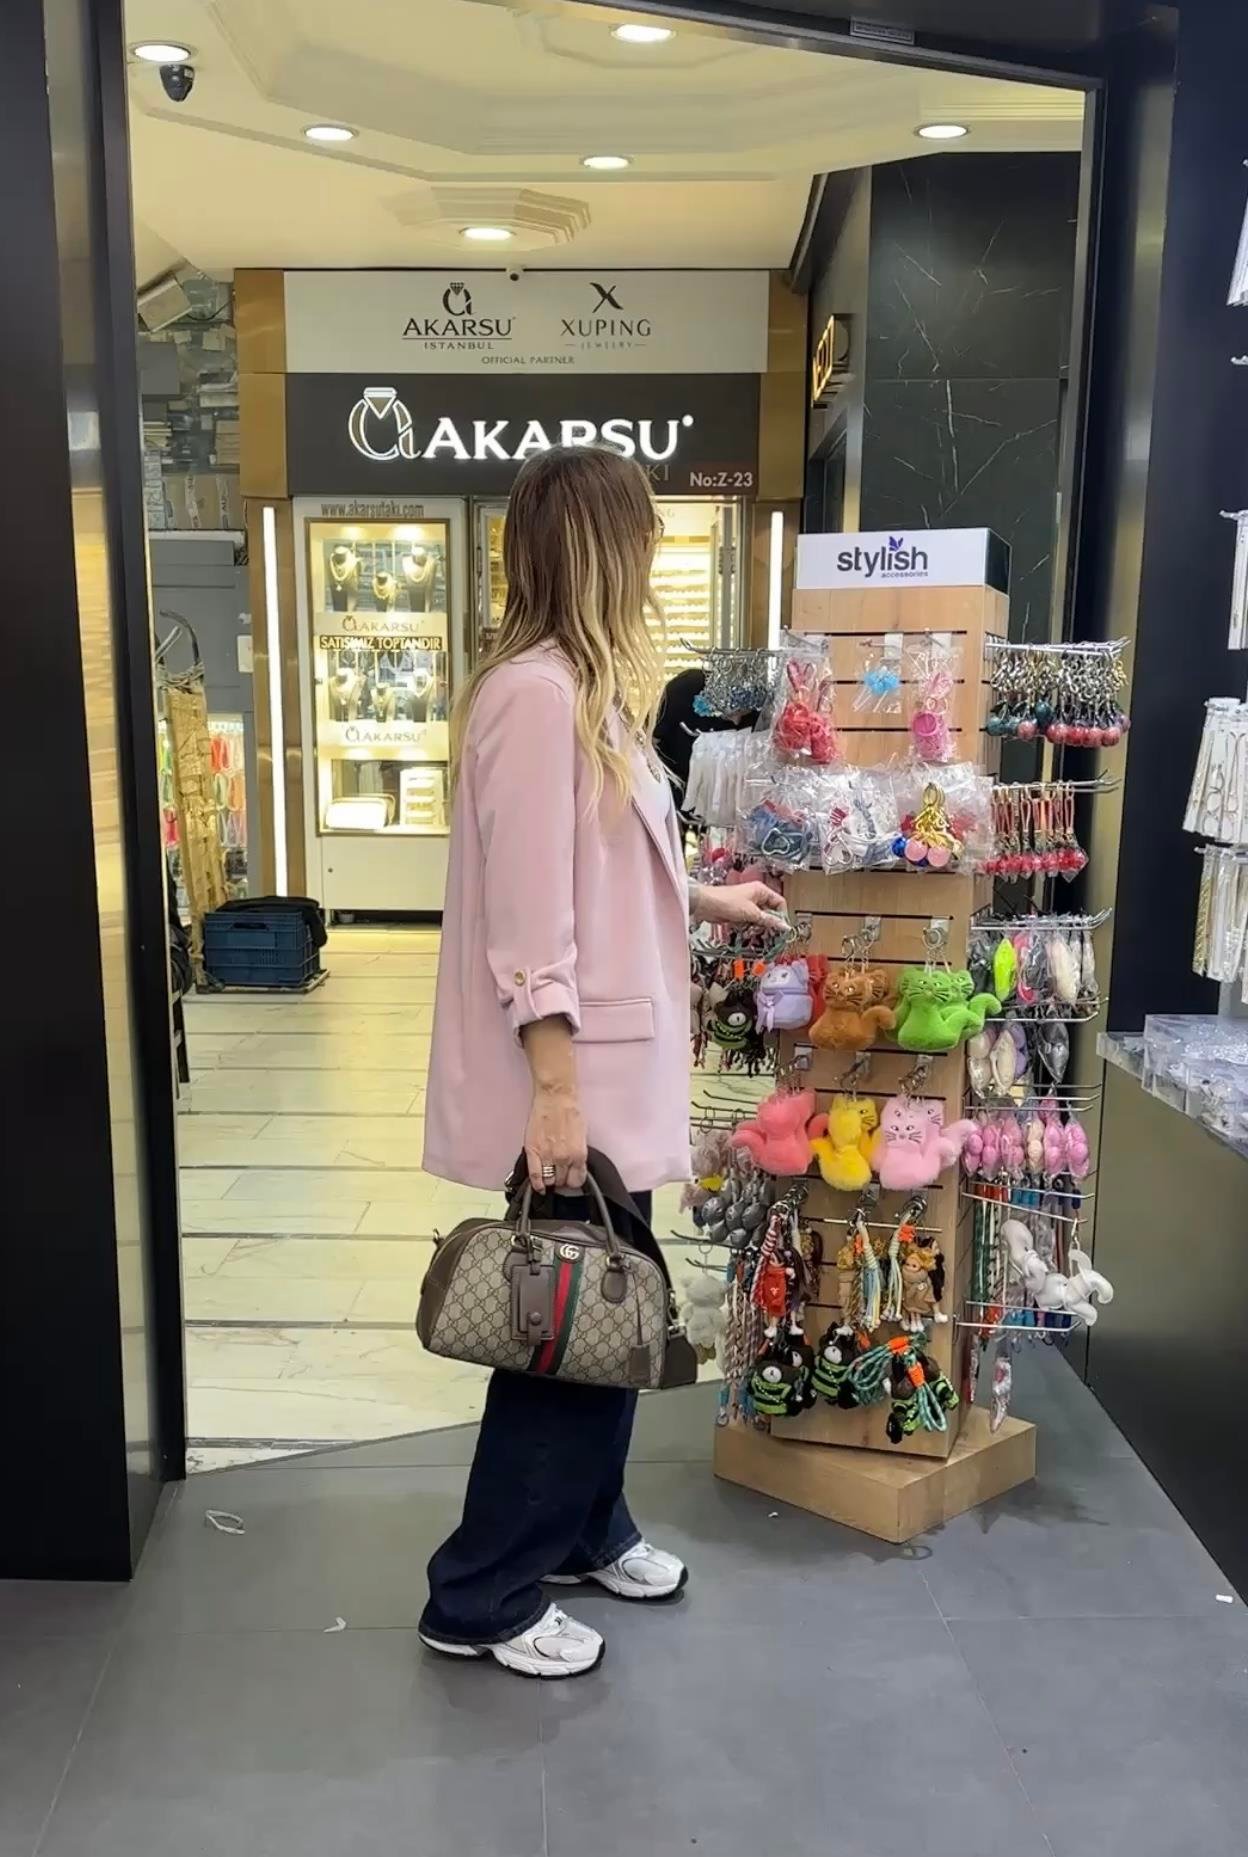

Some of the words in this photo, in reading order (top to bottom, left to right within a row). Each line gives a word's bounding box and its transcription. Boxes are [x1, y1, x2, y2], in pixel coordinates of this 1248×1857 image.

[403, 318, 512, 336] AKARSU
[561, 318, 651, 337] XUPING
[424, 342, 495, 350] ISTANBUL
[481, 356, 526, 365] OFFICIAL
[530, 356, 575, 365] PARTNER
[690, 471, 753, 489] No:Z-23
[836, 546, 928, 578] stylish
[358, 622, 419, 632] AKARSU
[363, 732, 421, 742] AKARSU
